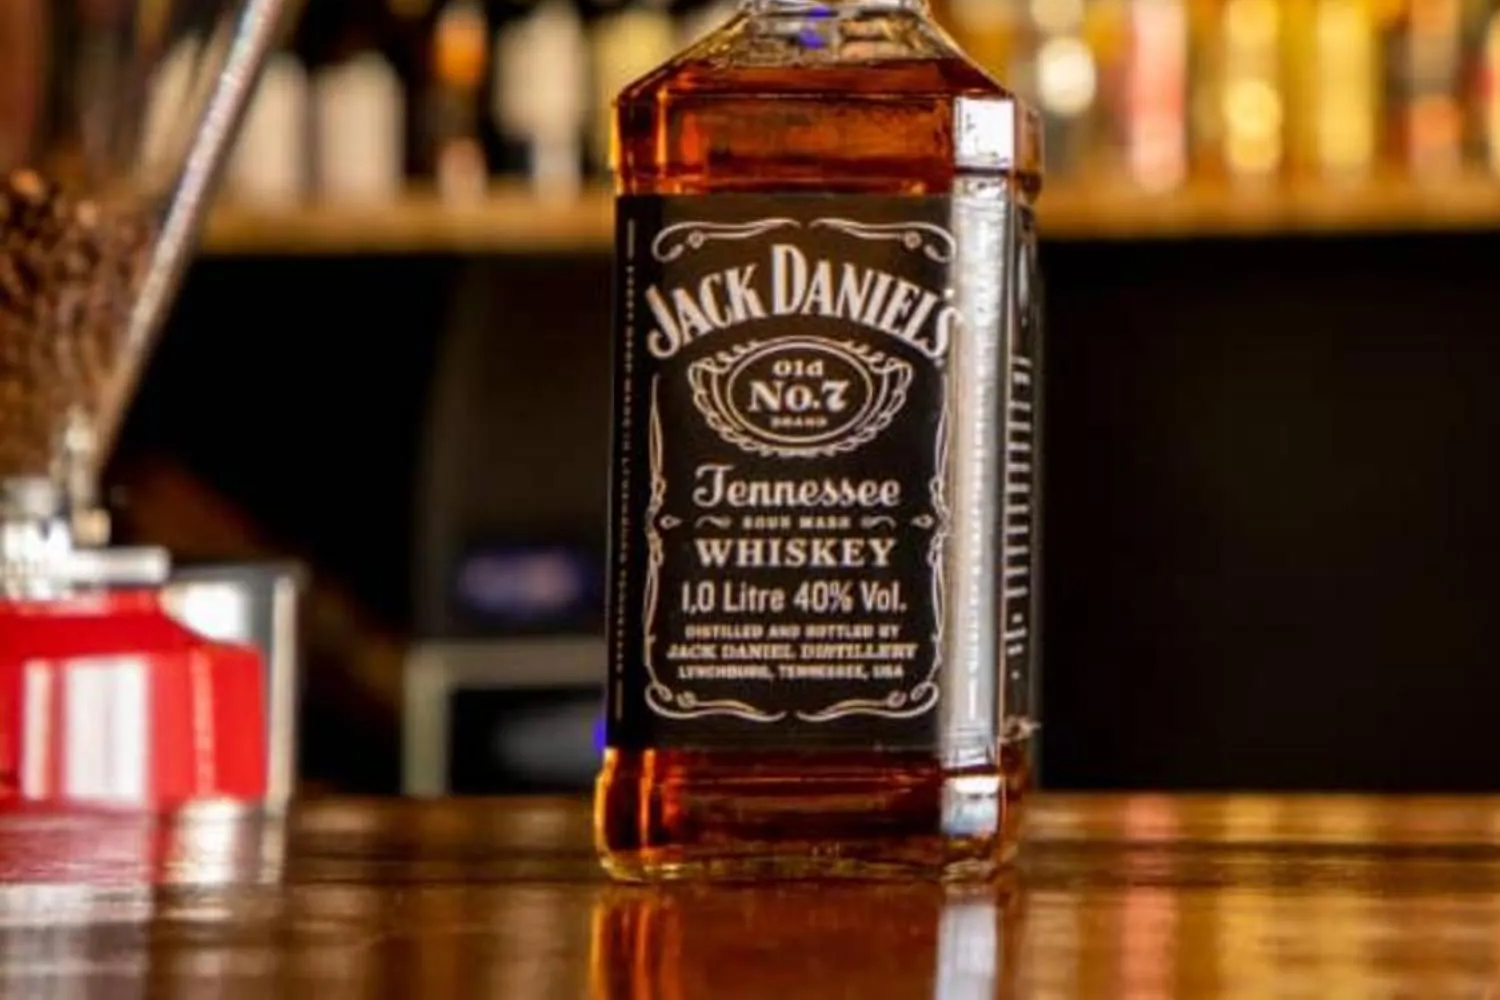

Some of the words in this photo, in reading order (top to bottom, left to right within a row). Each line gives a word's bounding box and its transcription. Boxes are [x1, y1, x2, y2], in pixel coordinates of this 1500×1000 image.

[645, 263, 767, 358] JACK
[773, 360, 824, 377] Old
[693, 464, 900, 507] Tennessee
[695, 538, 896, 568] WHISKEY
[723, 581, 785, 613] Litre
[793, 581, 854, 613] 40%
[860, 581, 908, 613] Vol.
[685, 624, 763, 638] DISTILLED
[767, 624, 800, 638] AND
[805, 624, 873, 638] BOTTLED
[667, 644, 716, 659] JACK
[721, 644, 796, 659] DANIEL
[801, 644, 918, 659] DISTILLERY
